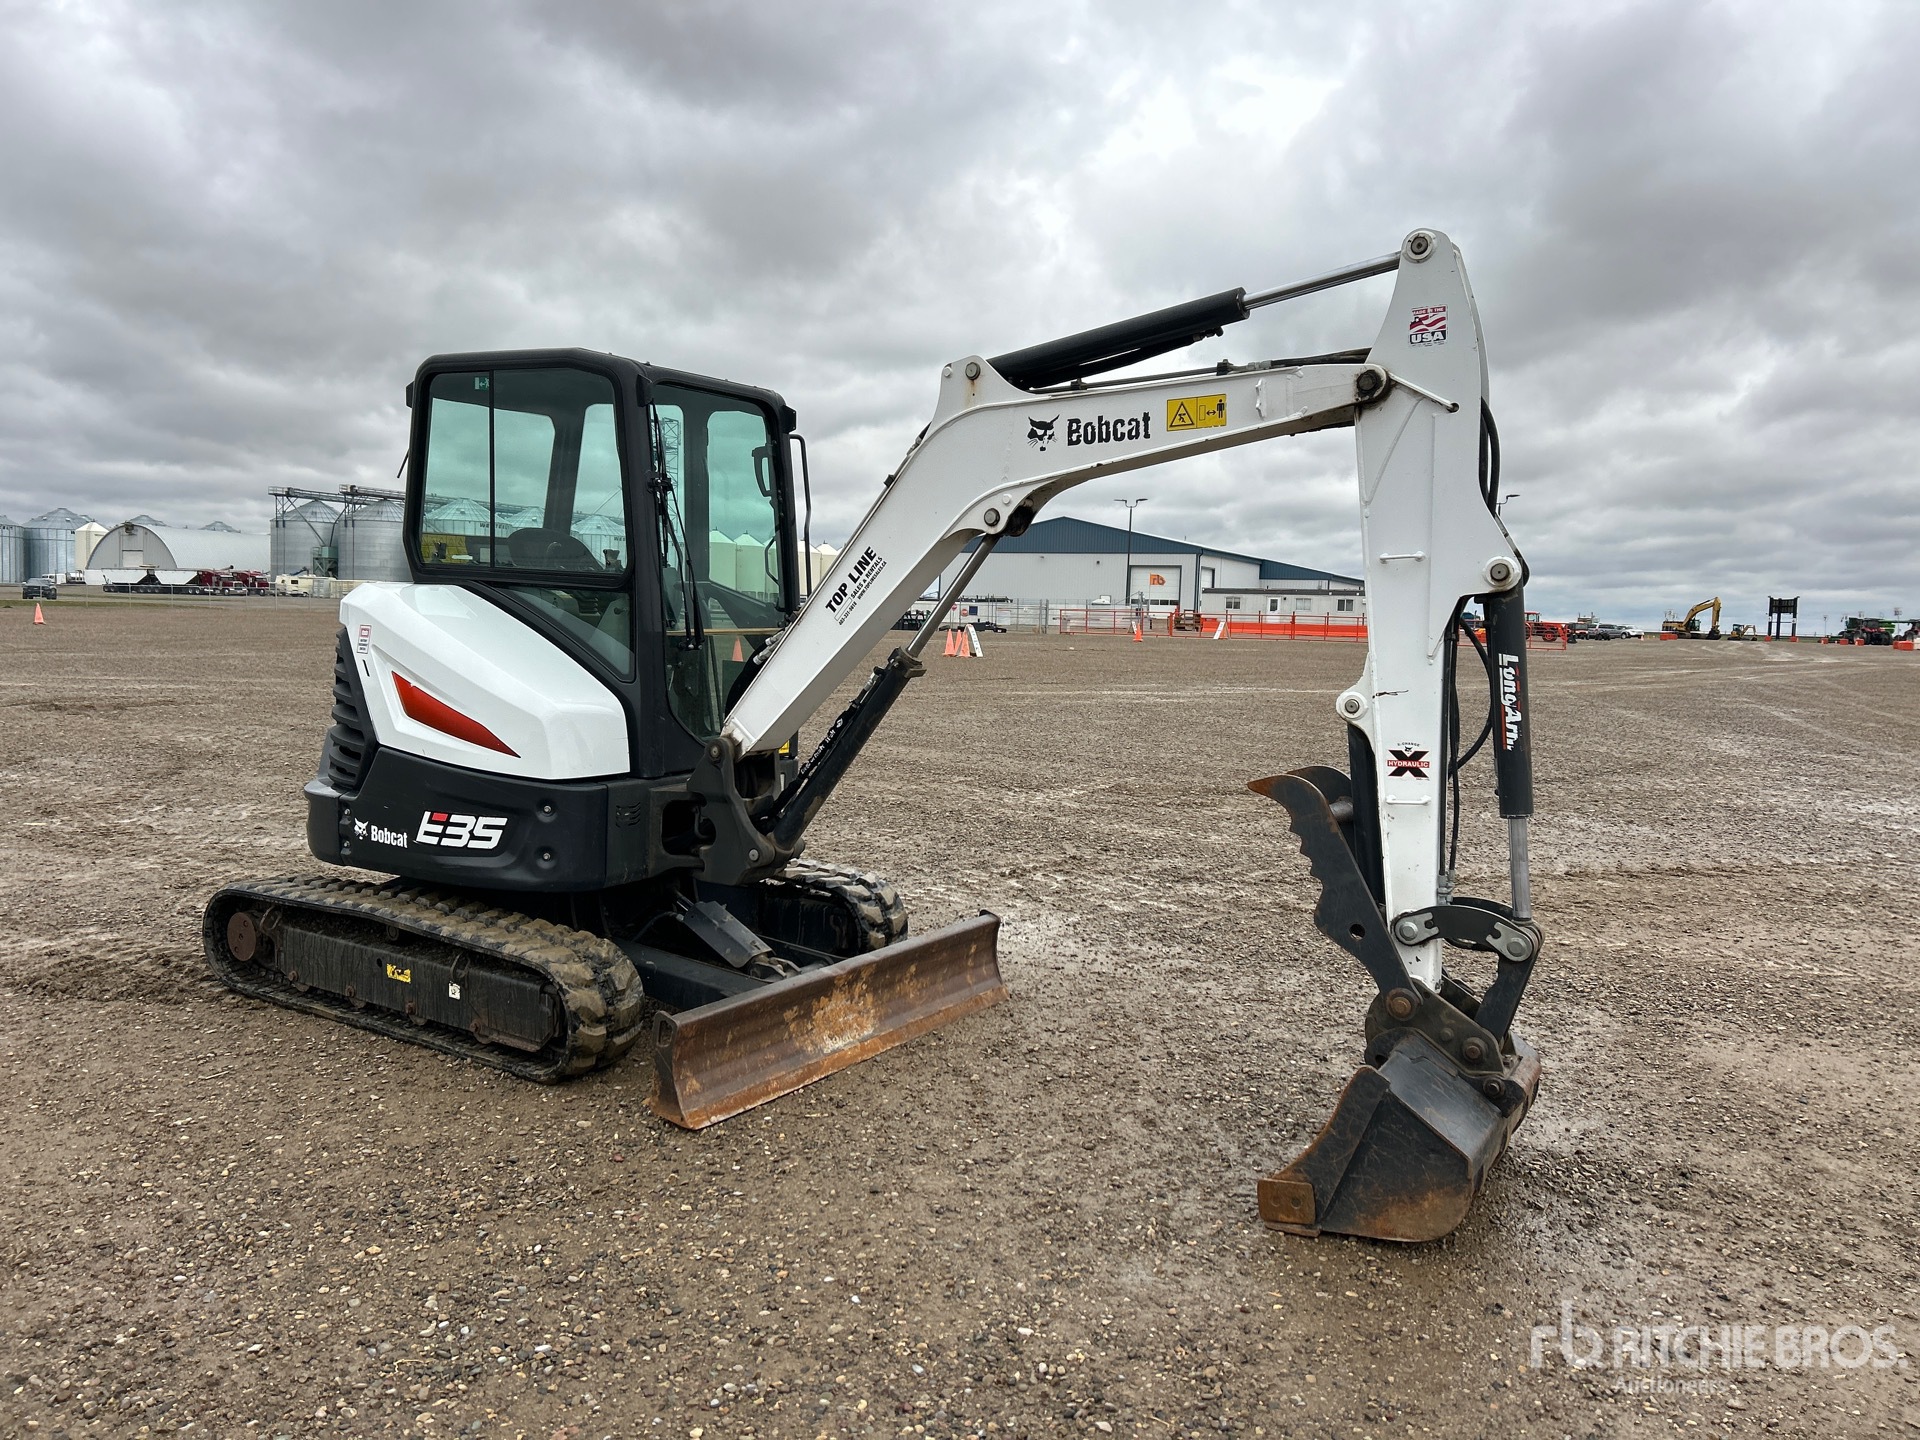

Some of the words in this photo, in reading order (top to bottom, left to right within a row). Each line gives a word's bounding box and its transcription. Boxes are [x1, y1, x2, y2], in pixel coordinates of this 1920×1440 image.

[1411, 331, 1444, 343] USA
[1067, 411, 1151, 446] Bobcat
[825, 582, 848, 613] TOP
[848, 546, 877, 584] LINE
[850, 582, 864, 599] SALES
[865, 556, 883, 578] RENTALS
[1388, 760, 1429, 768] HYDRAULIC
[371, 825, 408, 848] Bobcat
[416, 811, 508, 849] E35
